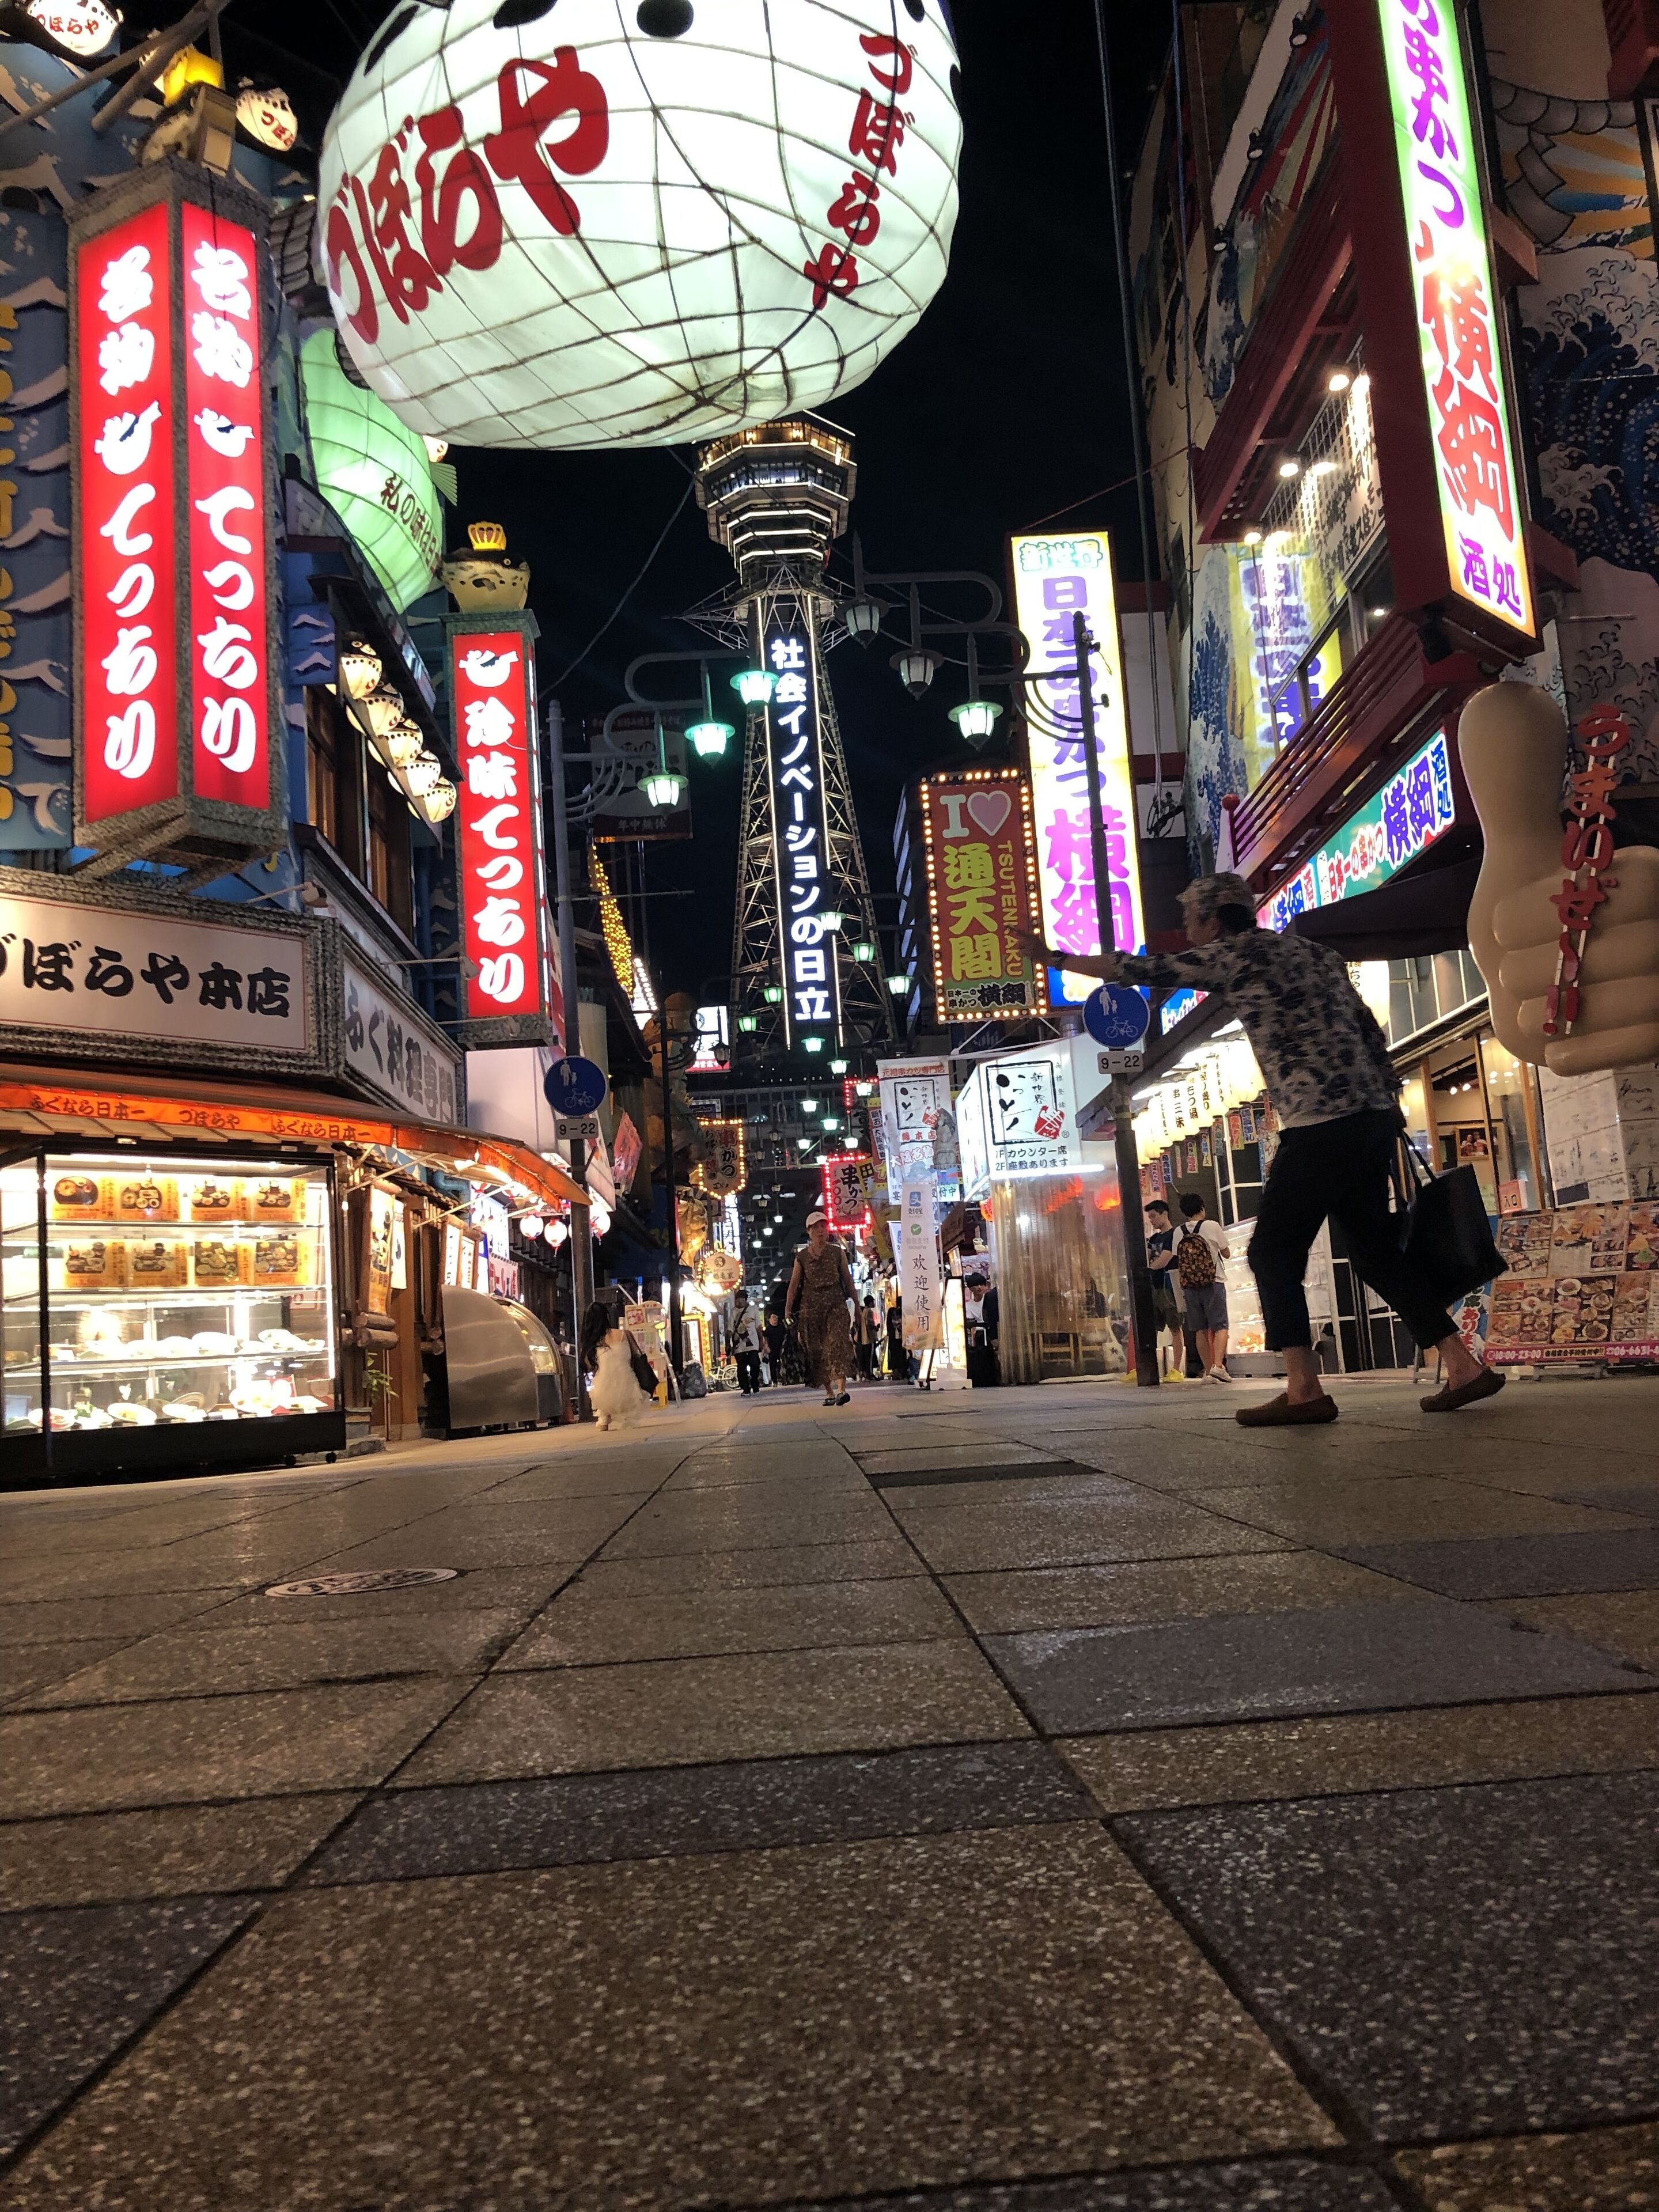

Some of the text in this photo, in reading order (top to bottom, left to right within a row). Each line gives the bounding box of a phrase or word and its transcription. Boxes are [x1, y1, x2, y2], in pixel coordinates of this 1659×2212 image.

[328, 46, 608, 344] づぼらや
[804, 34, 918, 309] づぼらや
[1018, 540, 1105, 571] 新世界
[1457, 532, 1522, 618] 酒処
[100, 483, 160, 779] てっちり
[194, 485, 258, 774] てっちり
[463, 697, 525, 1003] 珍味てっちり
[771, 637, 831, 1020] 社会イノベーションの日立
[943, 842, 1002, 982] 通天閣
[948, 989, 976, 997] 日本一の
[949, 998, 976, 1008] 串かつ
[977, 983, 1025, 1007] 横綱
[882, 1065, 945, 1077] 元祖串カツ専門店
[1008, 1145, 1067, 1157] カウンター席
[1009, 1158, 1069, 1170] 座敷あります
[841, 1164, 863, 1209] 串かつ
[1503, 1194, 1518, 1208] 入口
[912, 1253, 931, 1332] 欢迎使用
